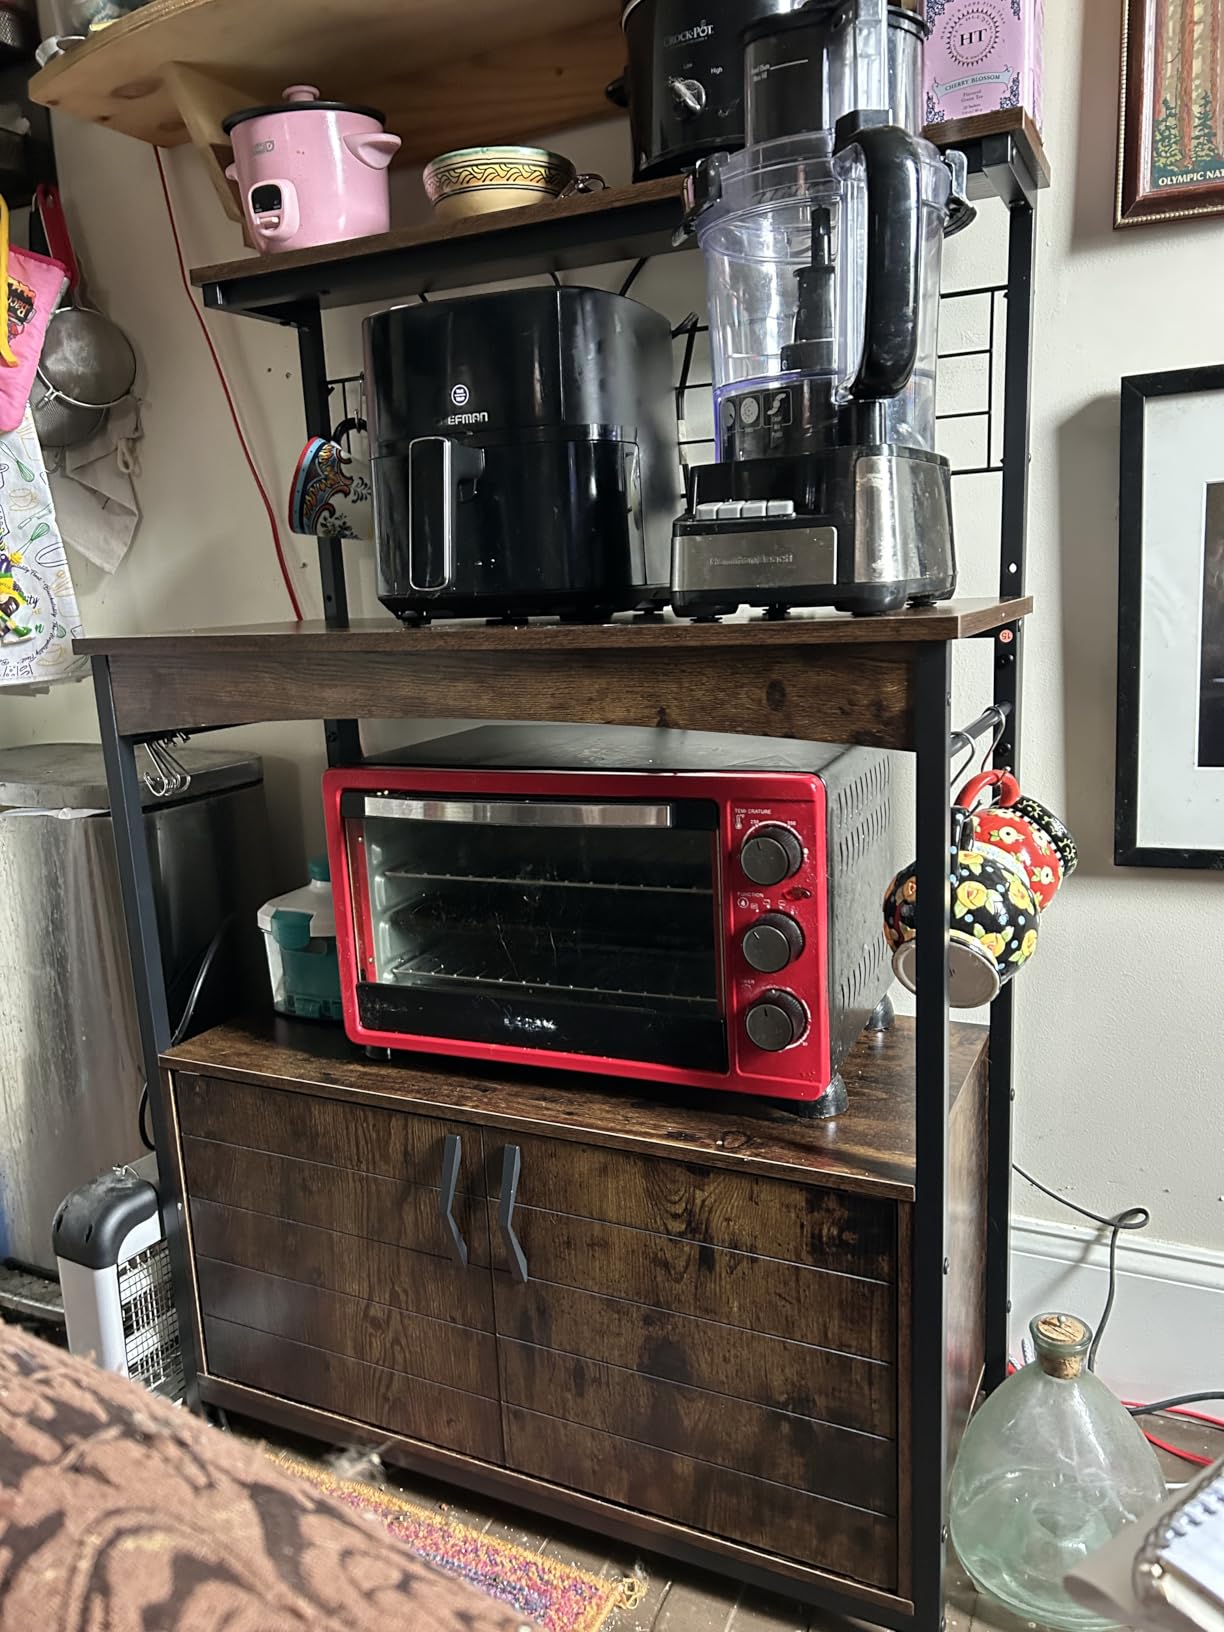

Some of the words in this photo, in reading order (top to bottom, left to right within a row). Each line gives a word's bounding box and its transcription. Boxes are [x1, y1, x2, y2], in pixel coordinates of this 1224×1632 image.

[960, 28, 988, 47] HT
[711, 66, 723, 74] High
[944, 80, 969, 91] CHERRY
[971, 74, 1000, 84] BLOSSOM
[1158, 171, 1205, 186] OLYMPIC
[1001, 632, 1011, 640] 15
